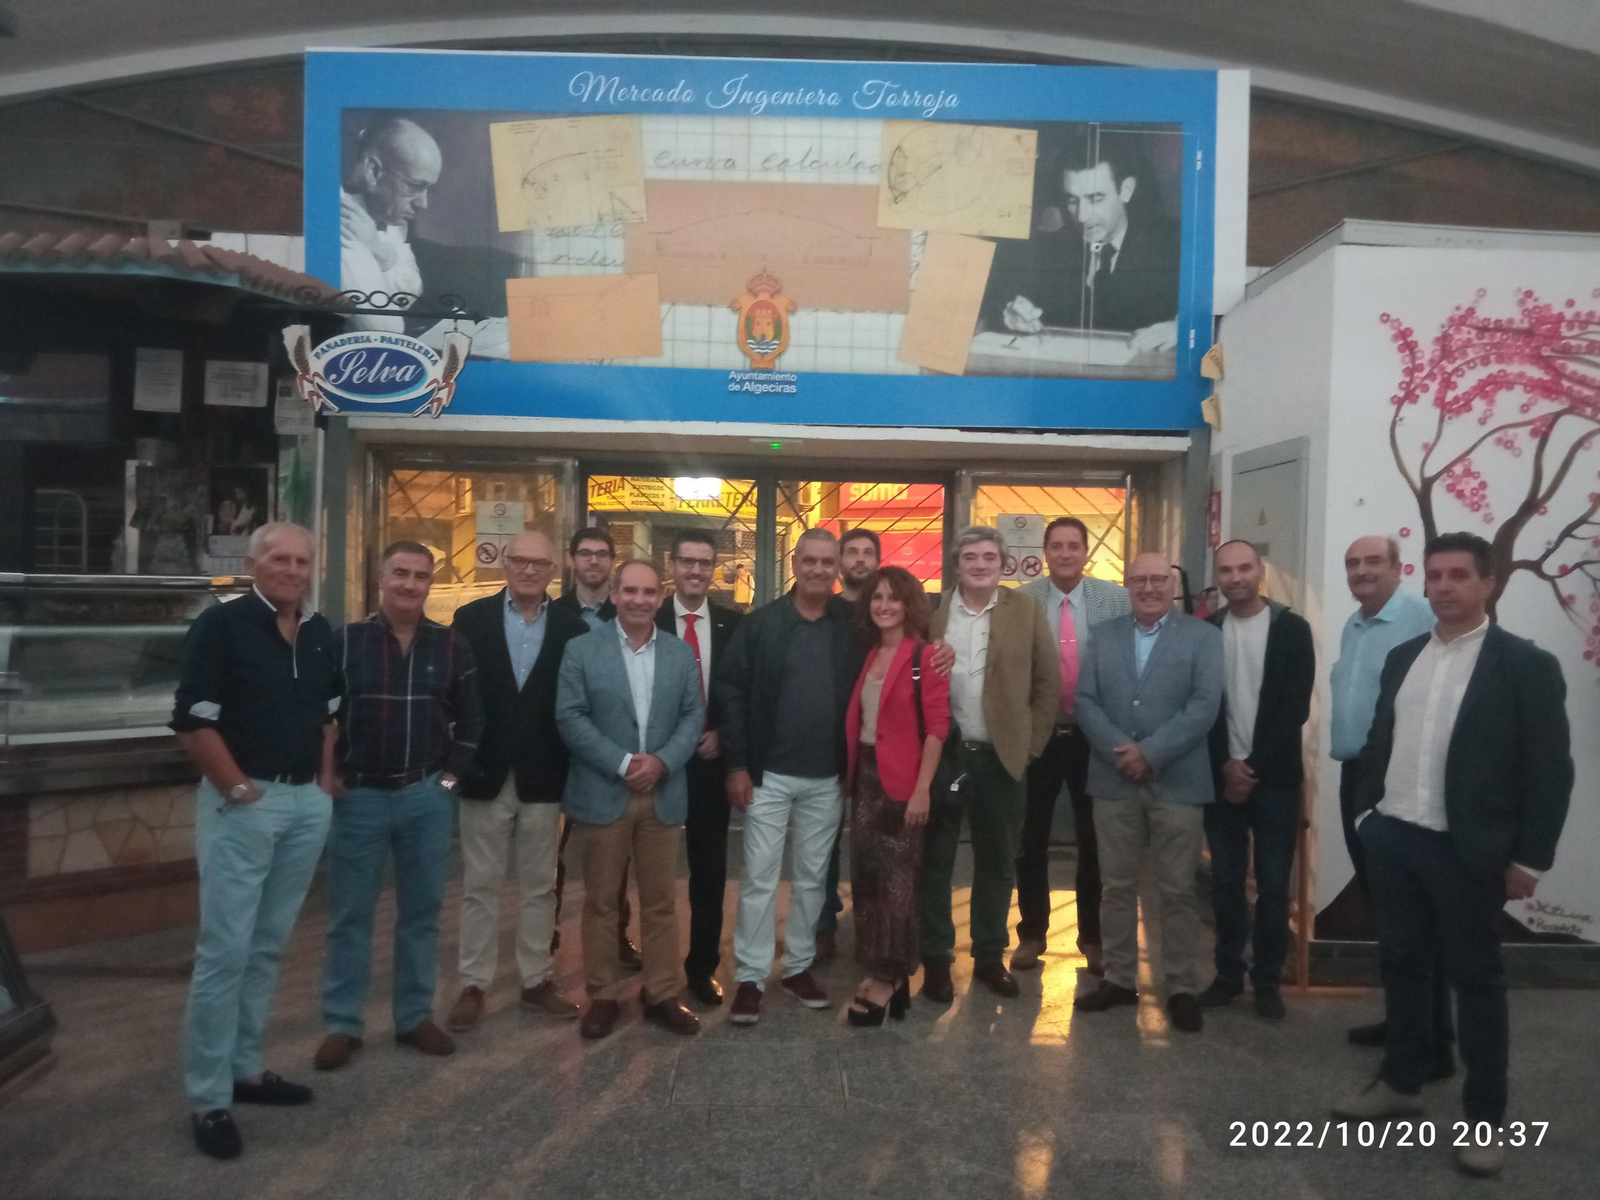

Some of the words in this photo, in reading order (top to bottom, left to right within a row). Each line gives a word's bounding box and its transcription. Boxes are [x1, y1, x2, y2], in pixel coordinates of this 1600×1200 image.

[568, 70, 696, 105] Mercado
[705, 73, 841, 116] Ingeniero
[852, 79, 960, 118] Torroja
[329, 350, 425, 385] Selva
[728, 370, 798, 381] Ayuntamiento
[728, 383, 741, 391] de
[742, 381, 797, 394] Algeciras
